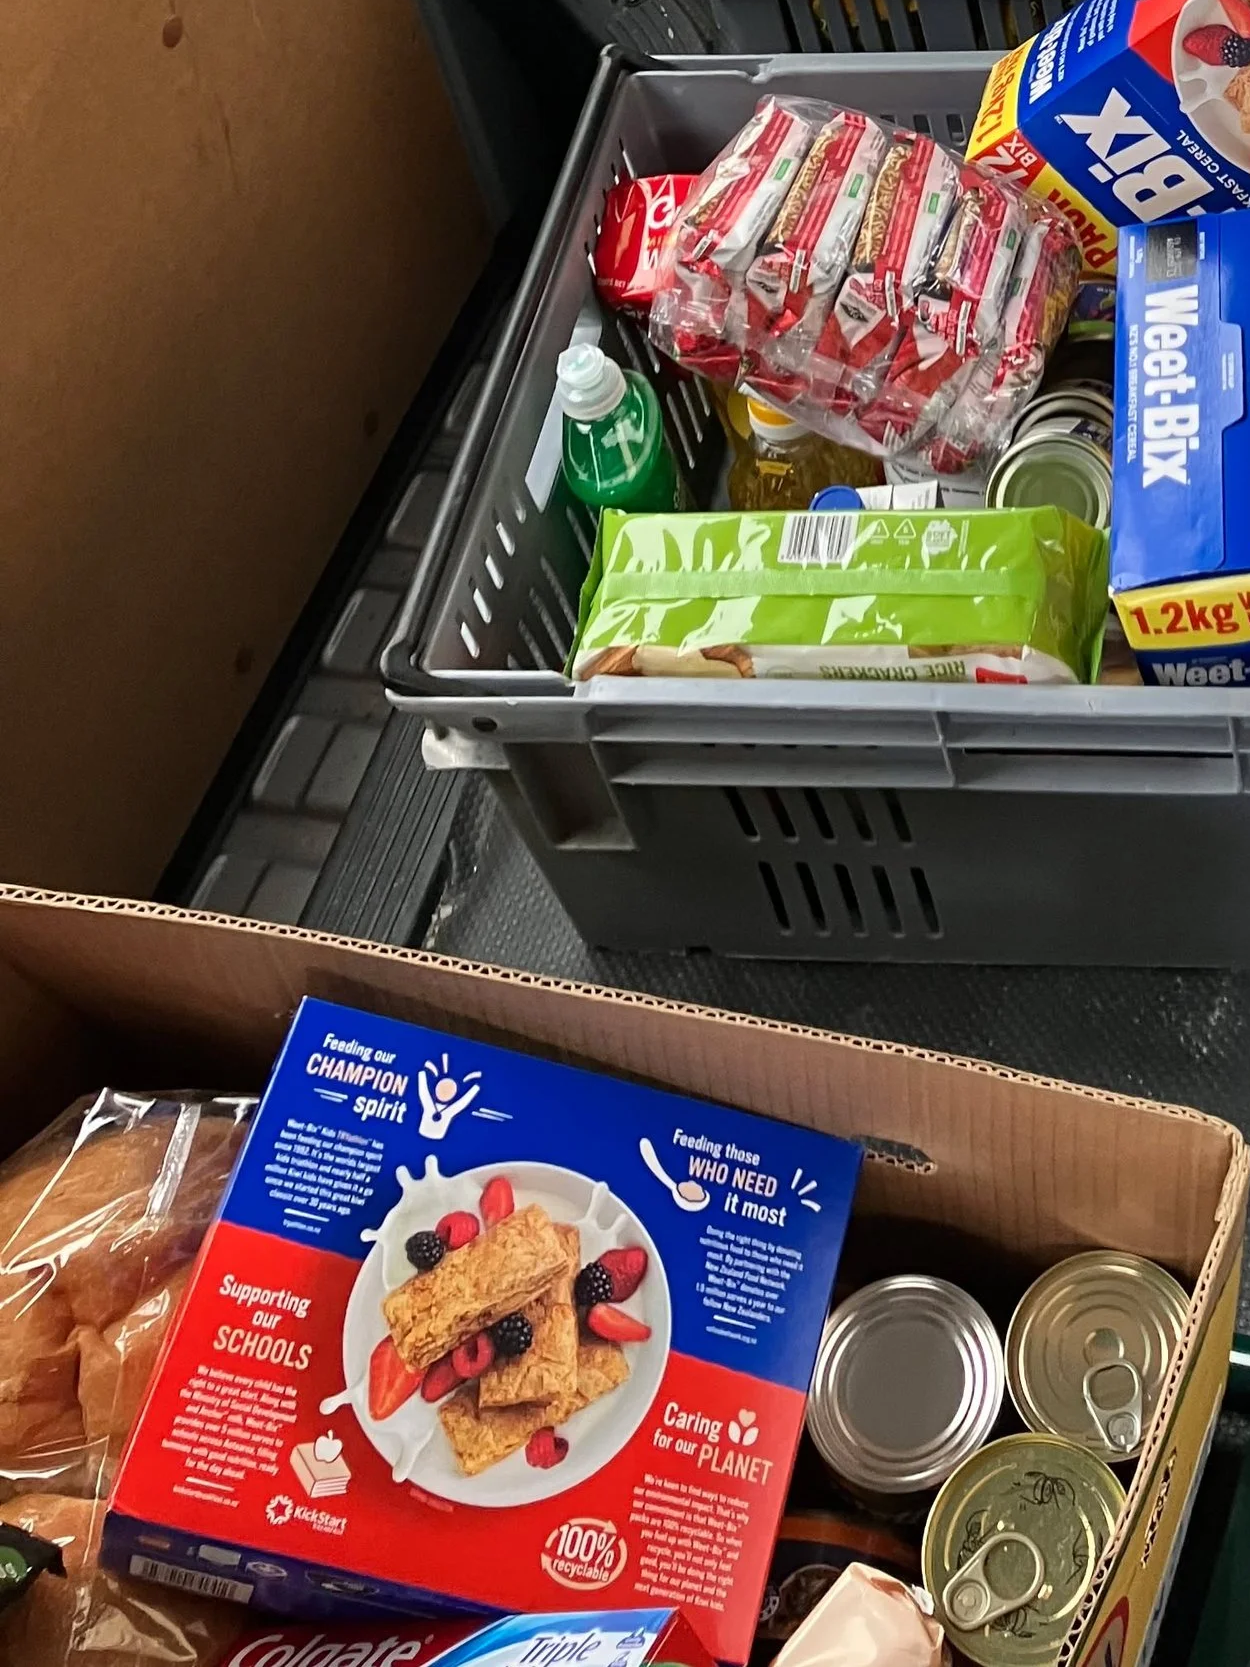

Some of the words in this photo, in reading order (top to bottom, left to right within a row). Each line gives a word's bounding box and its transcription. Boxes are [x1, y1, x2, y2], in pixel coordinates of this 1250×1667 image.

[1004, 135, 1037, 168] BIX
[1062, 89, 1215, 223] -Bix
[1176, 130, 1223, 174] CEREAL
[1127, 369, 1138, 422] BREAKFAST
[1142, 285, 1200, 488] Weet-Bix
[1126, 423, 1138, 464] CEREAL
[1130, 595, 1241, 636] 1.2kg
[820, 665, 917, 682] CRACKERS
[930, 661, 966, 678] RICE
[323, 1032, 373, 1062] Feeding
[374, 1048, 396, 1064] our
[306, 1053, 409, 1097] CHAMPION
[353, 1095, 407, 1124] spirit
[333, 1142, 365, 1157] champion
[673, 1128, 723, 1159] Feeding
[725, 1143, 761, 1166] those
[316, 1175, 334, 1186] have
[688, 1155, 729, 1184] WHO
[731, 1166, 778, 1198] NEED
[292, 1194, 309, 1205] over
[317, 1200, 337, 1212] years
[724, 1192, 738, 1214] it
[741, 1201, 788, 1227] most
[219, 1274, 312, 1318] Supporting
[252, 1310, 282, 1330] our
[213, 1325, 313, 1370] SCHOOLS
[664, 1402, 724, 1443] Caring
[653, 1428, 672, 1449] for
[675, 1438, 699, 1455] our
[698, 1444, 774, 1485] PLANET
[294, 1506, 348, 1528] KickStart
[557, 1523, 615, 1568] 100%
[552, 1557, 610, 1583] recyclable
[229, 1634, 414, 1667] Colgate
[519, 1632, 603, 1662] Triple
